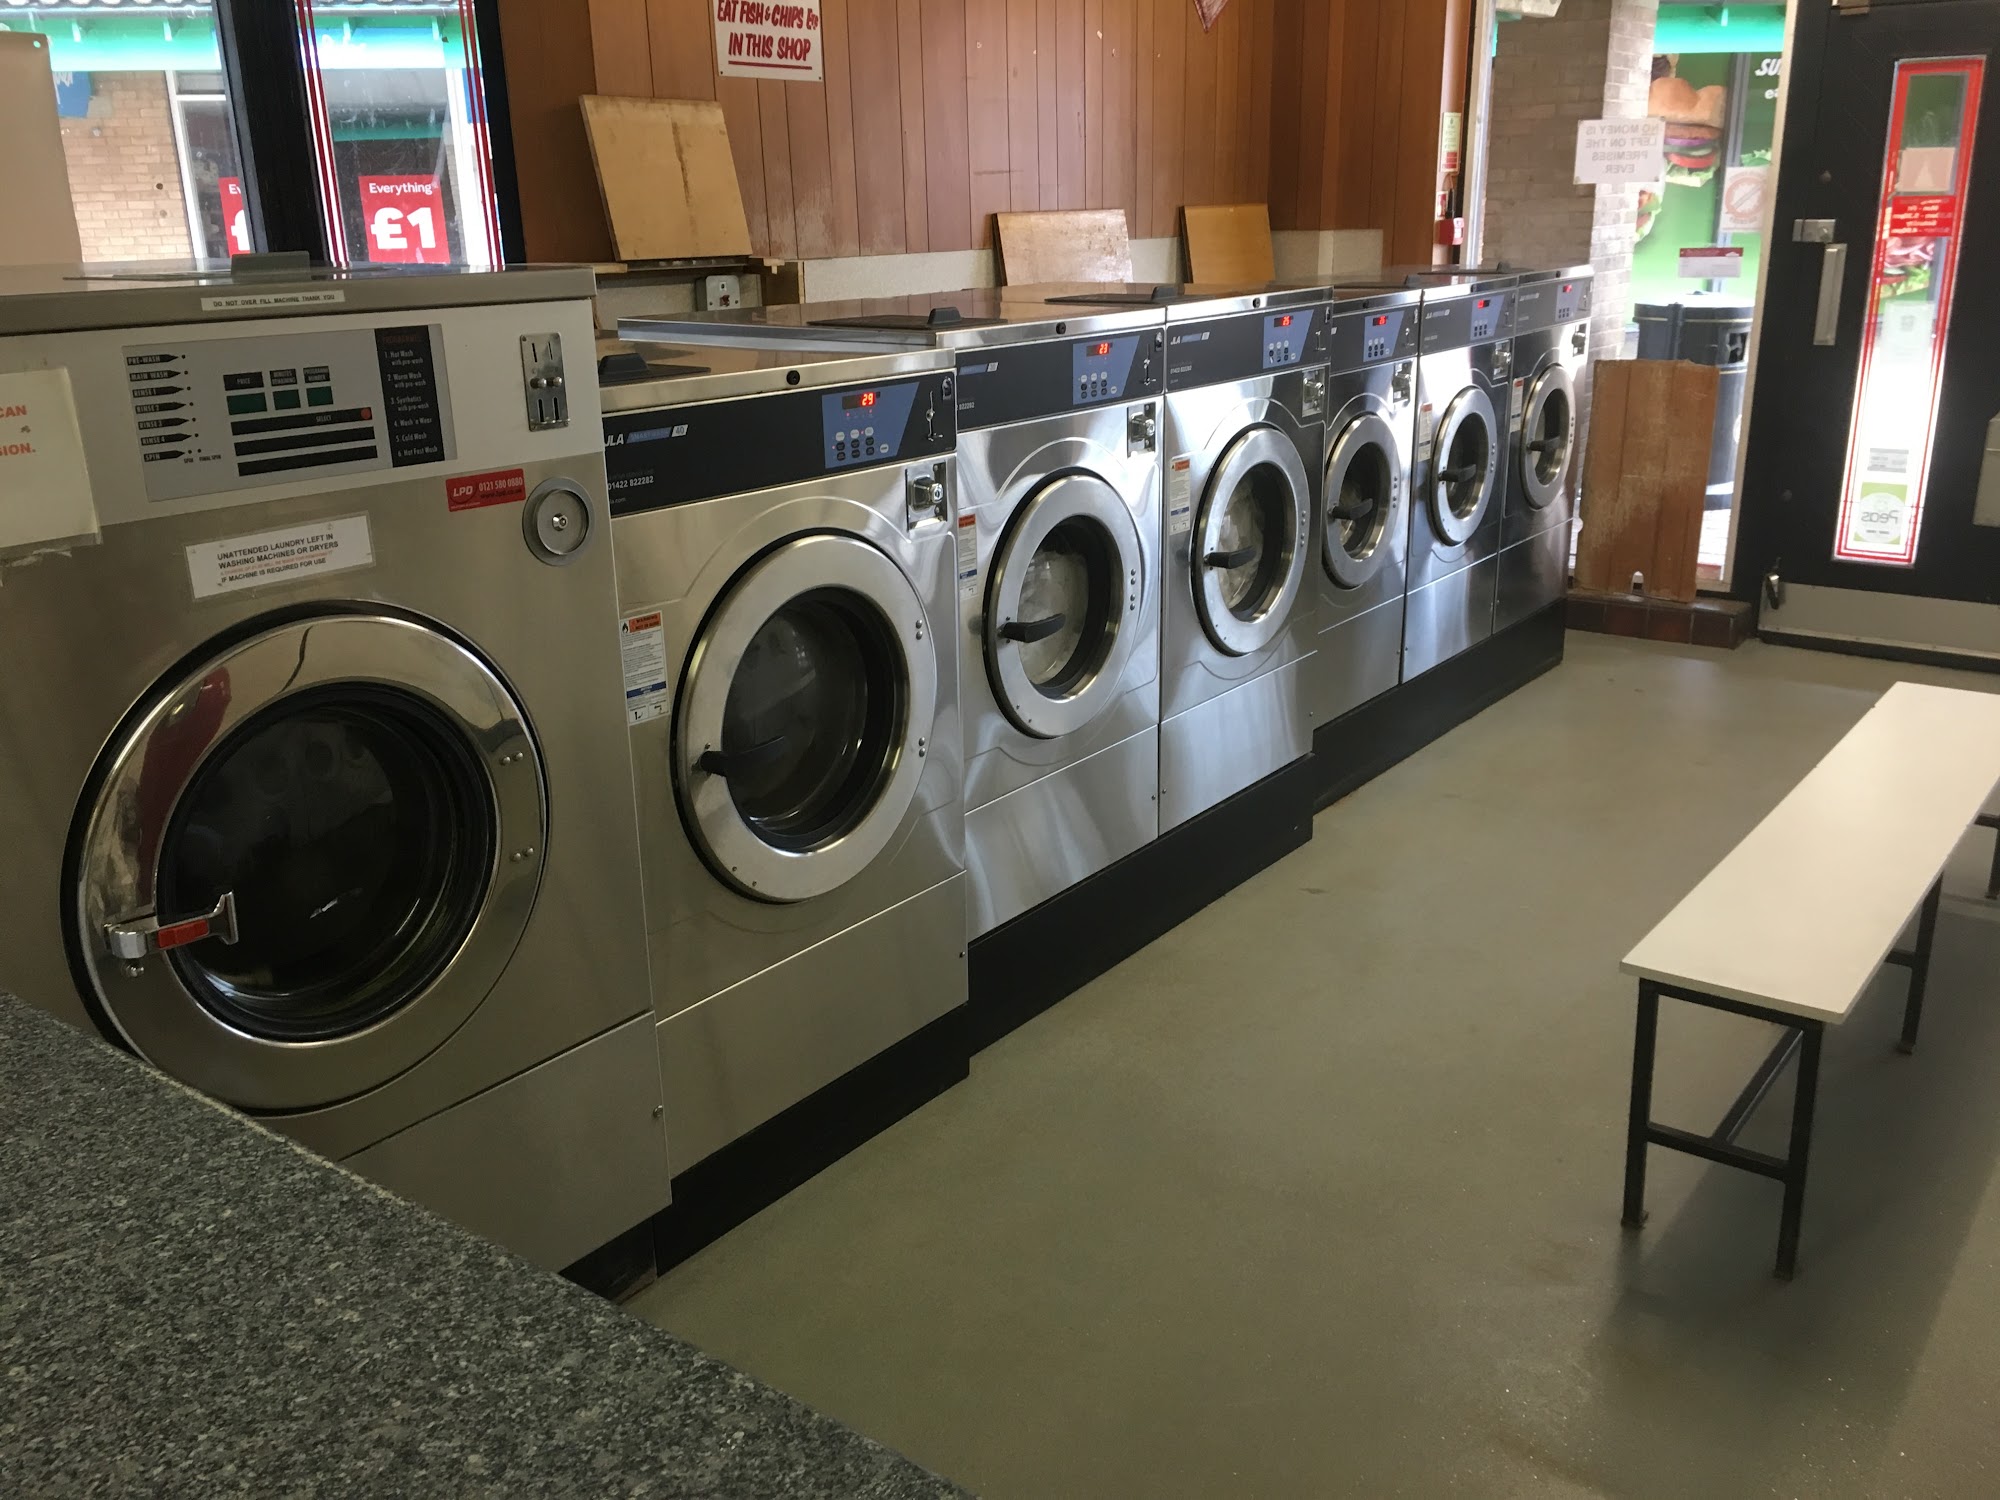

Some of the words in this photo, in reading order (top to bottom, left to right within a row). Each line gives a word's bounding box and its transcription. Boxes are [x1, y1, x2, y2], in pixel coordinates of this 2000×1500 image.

[717, 0, 739, 22] EAT
[740, 1, 764, 25] FISH
[772, 5, 804, 29] CHIPS
[728, 32, 744, 56] IN
[746, 33, 773, 58] THIS
[777, 37, 811, 61] SHOP
[369, 183, 433, 196] Everything
[370, 207, 436, 249] £1
[400, 349, 414, 357] Wash
[128, 355, 160, 364] PRE-WASH
[408, 371, 422, 379] Wash
[134, 388, 151, 396] RINSE
[397, 395, 422, 404] Synthetics
[861, 393, 873, 406] 29
[137, 404, 154, 412] RINSE
[140, 420, 157, 428] RINSE
[400, 419, 413, 427] Wash
[401, 434, 413, 442] Cold
[414, 432, 427, 440] Wash
[605, 433, 624, 446] JLA
[675, 426, 685, 434] 40
[424, 445, 438, 454] Wash
[479, 481, 494, 491] 0121
[495, 479, 506, 489] 580
[507, 477, 523, 487] 0880
[629, 475, 654, 487] 822282
[453, 486, 473, 497] LPD
[217, 544, 269, 560] UNATTENDED
[270, 538, 305, 551] LAUNDRY
[306, 534, 325, 544] LEFT
[218, 557, 255, 569] WASHING
[256, 548, 296, 562] MACHINES
[297, 546, 308, 554] OR
[309, 541, 339, 552] DRYERS
[229, 571, 258, 582] MACHINE
[267, 563, 299, 575] REQUIRED
[300, 560, 312, 568] FOR
[314, 557, 326, 565] USE
